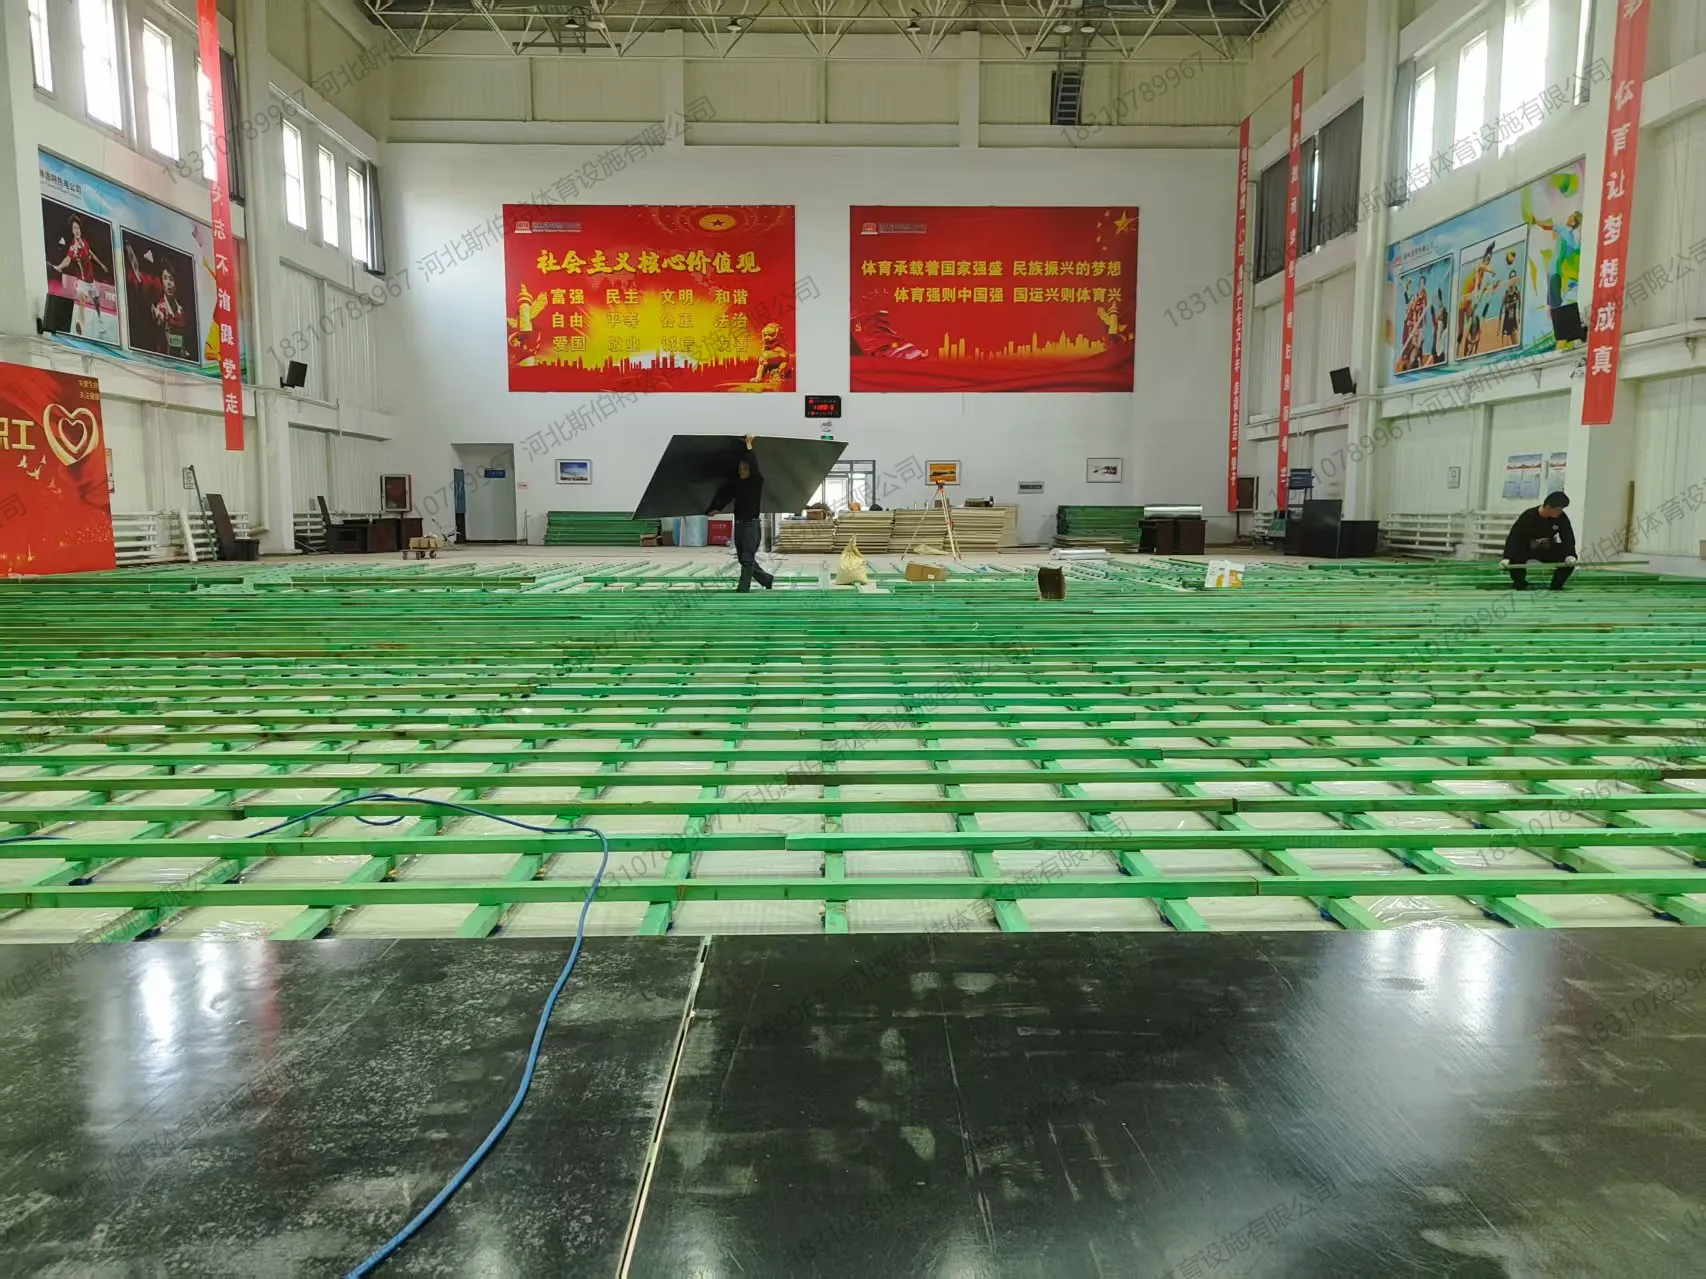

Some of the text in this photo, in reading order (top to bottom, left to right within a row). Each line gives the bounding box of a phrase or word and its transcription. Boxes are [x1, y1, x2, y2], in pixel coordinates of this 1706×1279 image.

[1592, 80, 1634, 376] 体育让梦想成真
[536, 250, 761, 275] 社会主义核心价值观
[861, 261, 1122, 276] 体育承载着国家强盛 民族振兴的梦想
[551, 289, 749, 305] 富强 民主 文明 和谐
[894, 287, 1122, 303] 体育强则中国强 国运兴则体育兴
[552, 312, 748, 329] 自由 平等 公正 法治
[553, 336, 587, 353] 爱国
